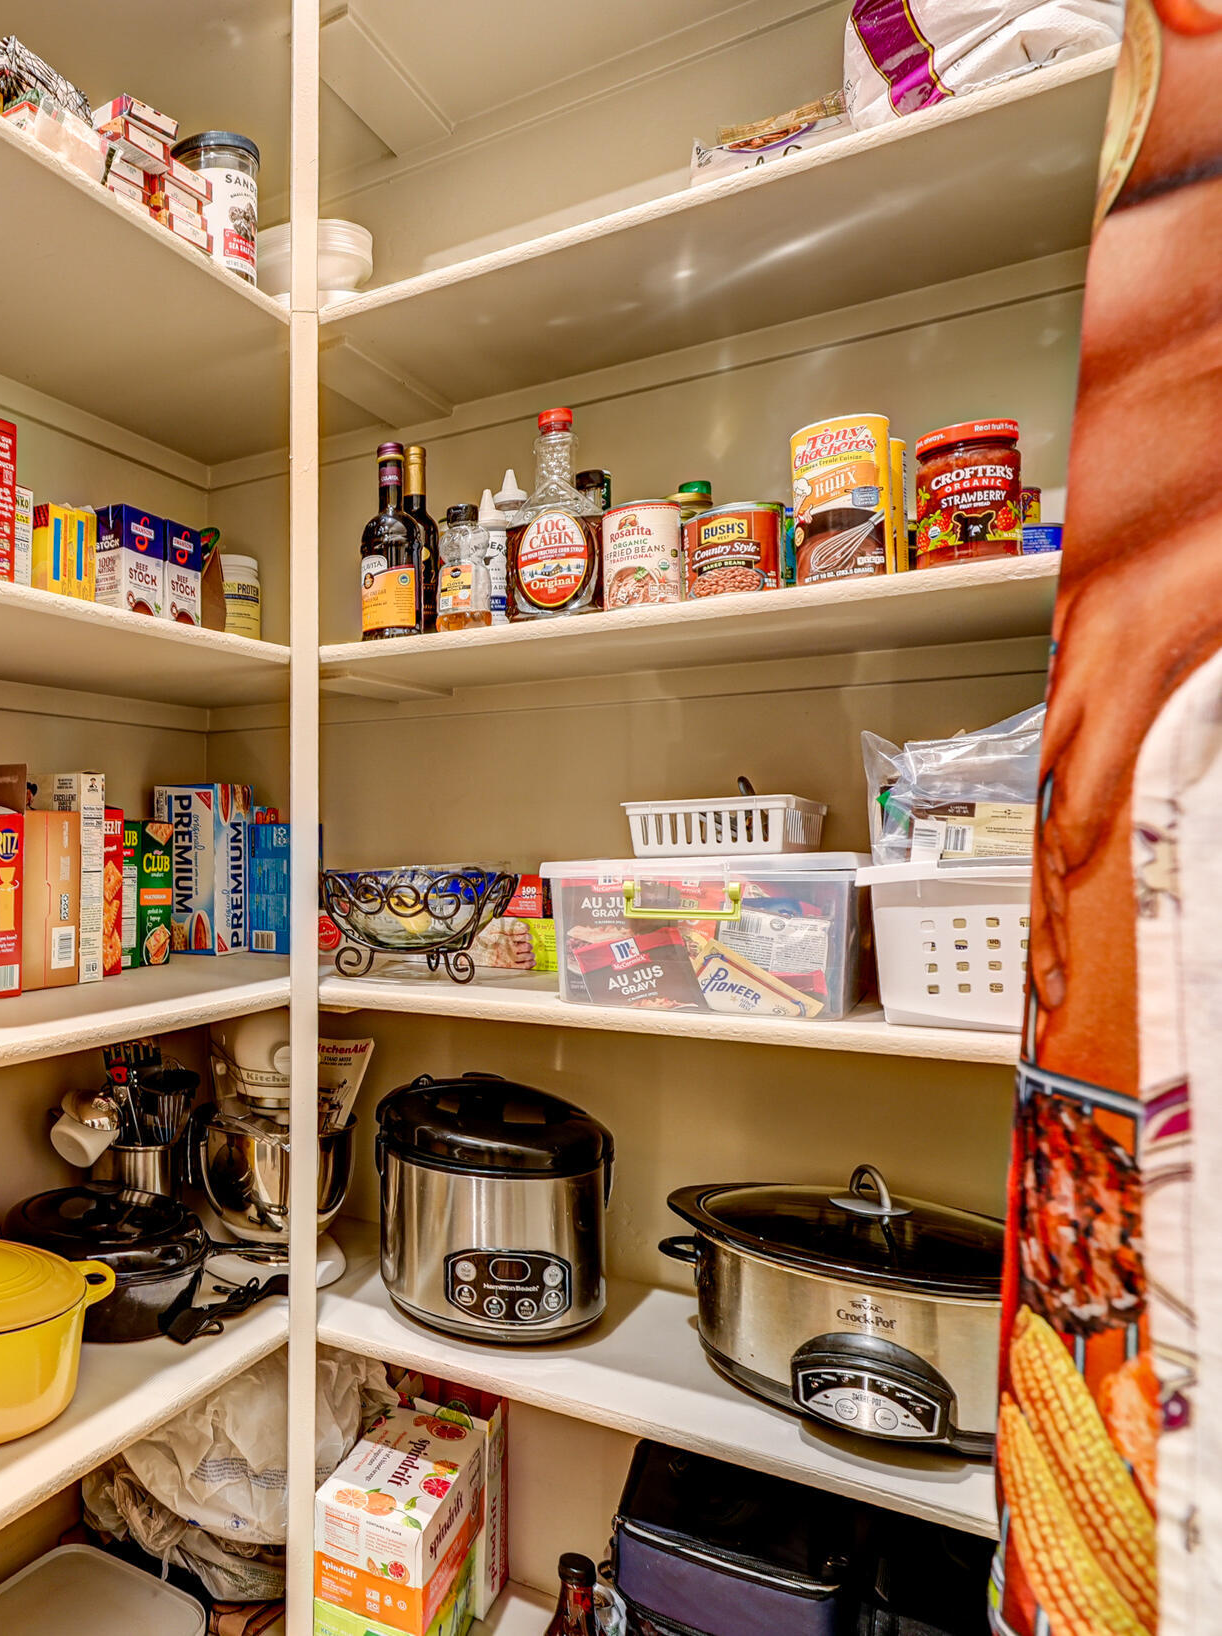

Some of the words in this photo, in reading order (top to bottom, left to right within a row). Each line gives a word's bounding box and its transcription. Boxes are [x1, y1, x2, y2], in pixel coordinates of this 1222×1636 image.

[974, 424, 990, 433] Real
[991, 422, 1004, 430] fruit
[807, 425, 867, 450] Tony
[931, 465, 1014, 490] CROFTER'S
[944, 479, 1002, 493] ORGANIC
[941, 490, 1006, 509] STRAWBERRY
[536, 518, 566, 535] LOG
[610, 526, 652, 543] Rosarita
[703, 522, 745, 539] BUSH'S
[96, 538, 119, 550] STOCK
[529, 531, 574, 549] CABIN
[613, 538, 648, 549] ORGANIC
[634, 544, 666, 554] BEANS
[695, 543, 731, 560] Country
[733, 541, 757, 554] Style
[136, 562, 148, 572] BEEF
[610, 554, 652, 564] TRADITIONAL
[702, 562, 722, 572] BAKED
[129, 567, 157, 586] STOCK
[177, 574, 188, 583] BEEF
[530, 575, 575, 590] Original
[171, 580, 195, 597] STOCK
[174, 794, 193, 914] PREMIUM
[143, 852, 170, 874] CLUB
[230, 822, 243, 948] PREMIUM
[581, 897, 602, 909] AU
[612, 954, 648, 970] McCormick
[608, 974, 629, 990] AU
[632, 965, 664, 984] JUS
[702, 967, 761, 1005] PIONEER
[621, 979, 657, 996] GRAVY
[318, 1043, 369, 1055] itchenAid
[483, 1283, 516, 1292] Hamilton
[516, 1285, 539, 1293] Beach
[387, 1437, 431, 1488] spindrift
[429, 1490, 464, 1561] spindrift
[322, 1560, 358, 1580] spindrift
